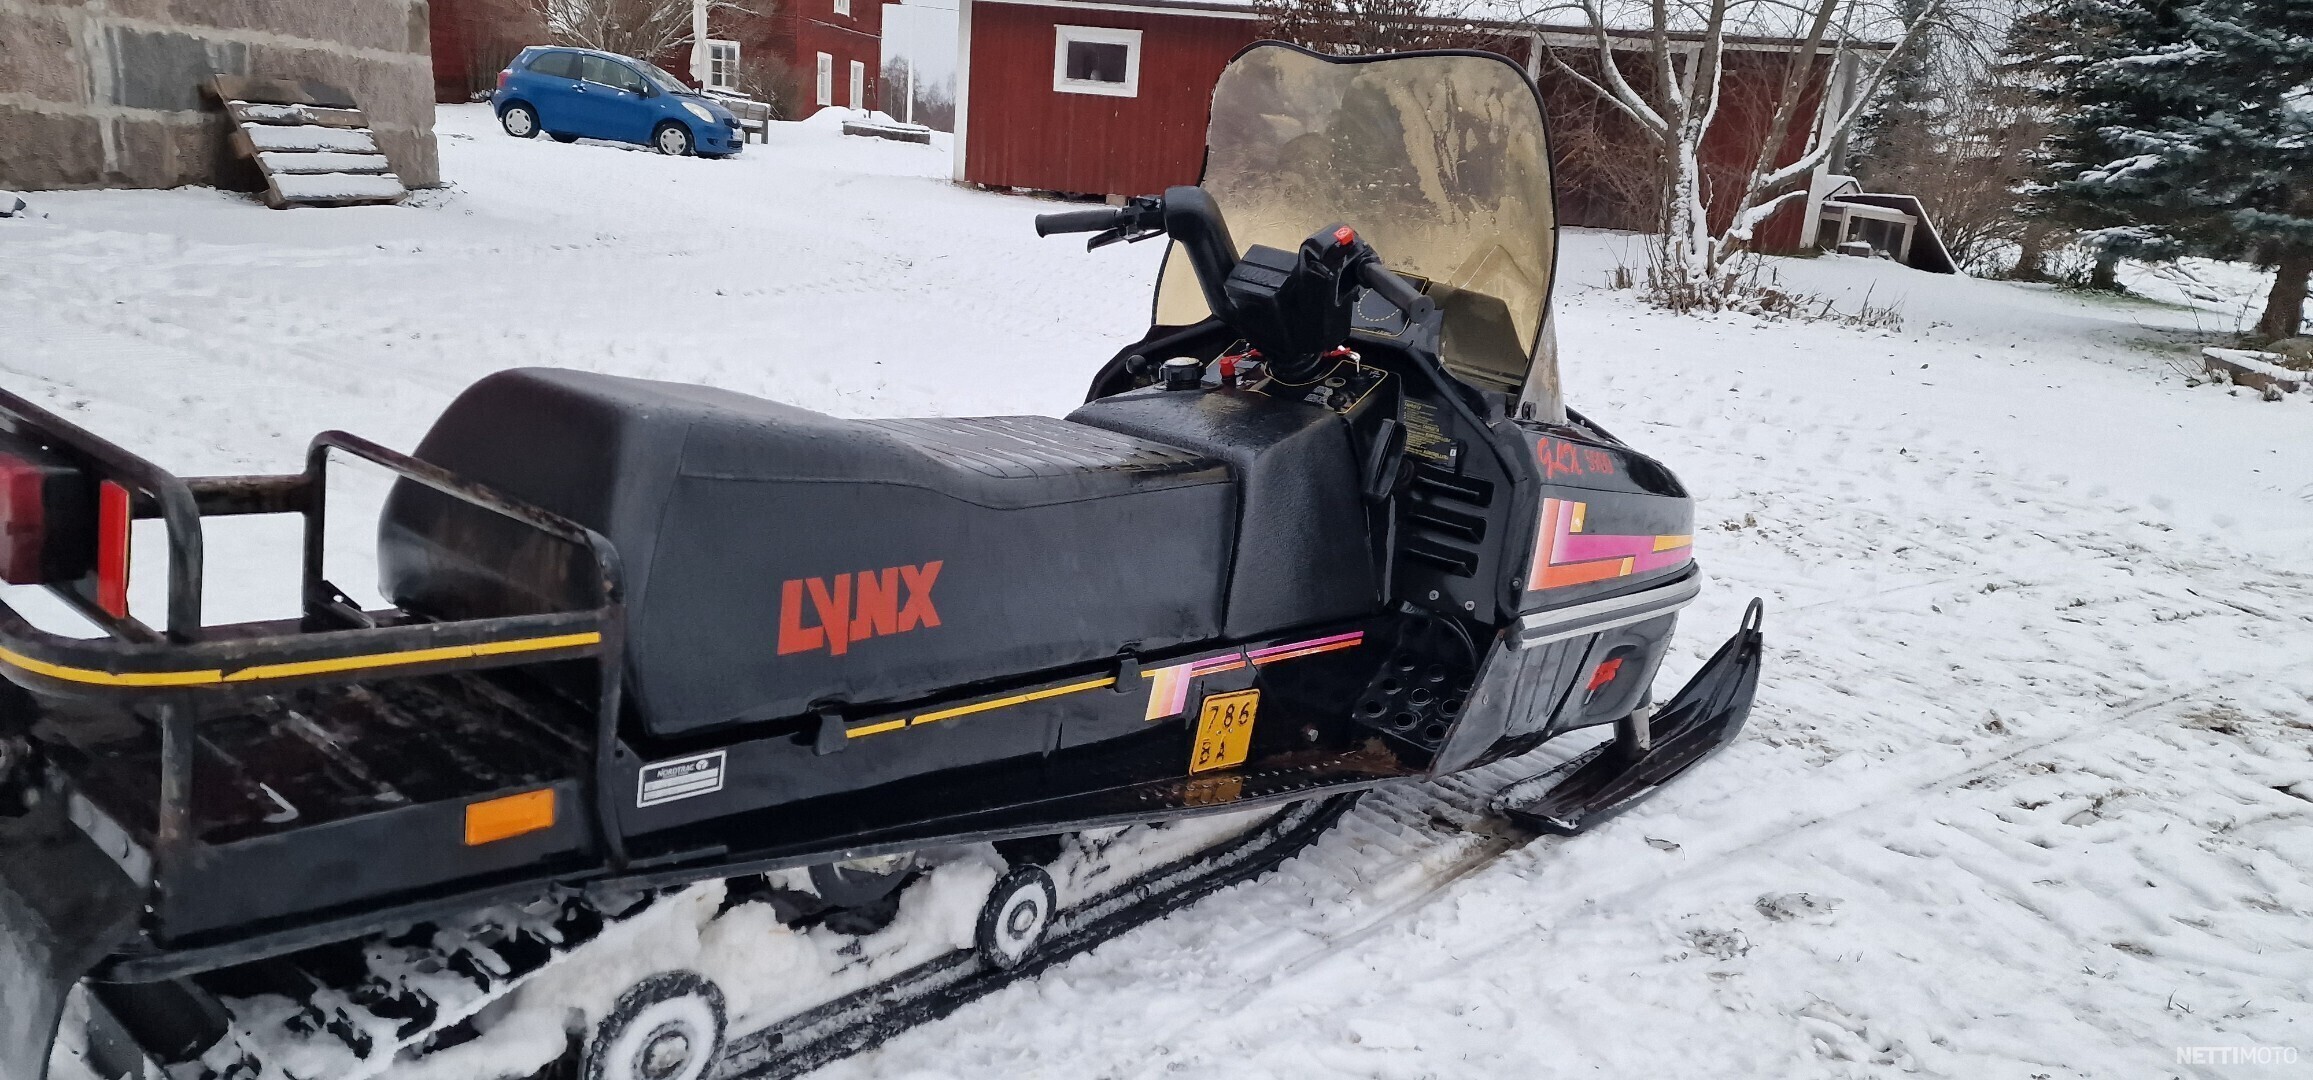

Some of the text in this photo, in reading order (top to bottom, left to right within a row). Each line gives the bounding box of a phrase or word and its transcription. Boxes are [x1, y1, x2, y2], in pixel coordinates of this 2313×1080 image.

[777, 560, 943, 656] LYNX
[1207, 701, 1250, 732] 786
[1199, 736, 1225, 765] BA
